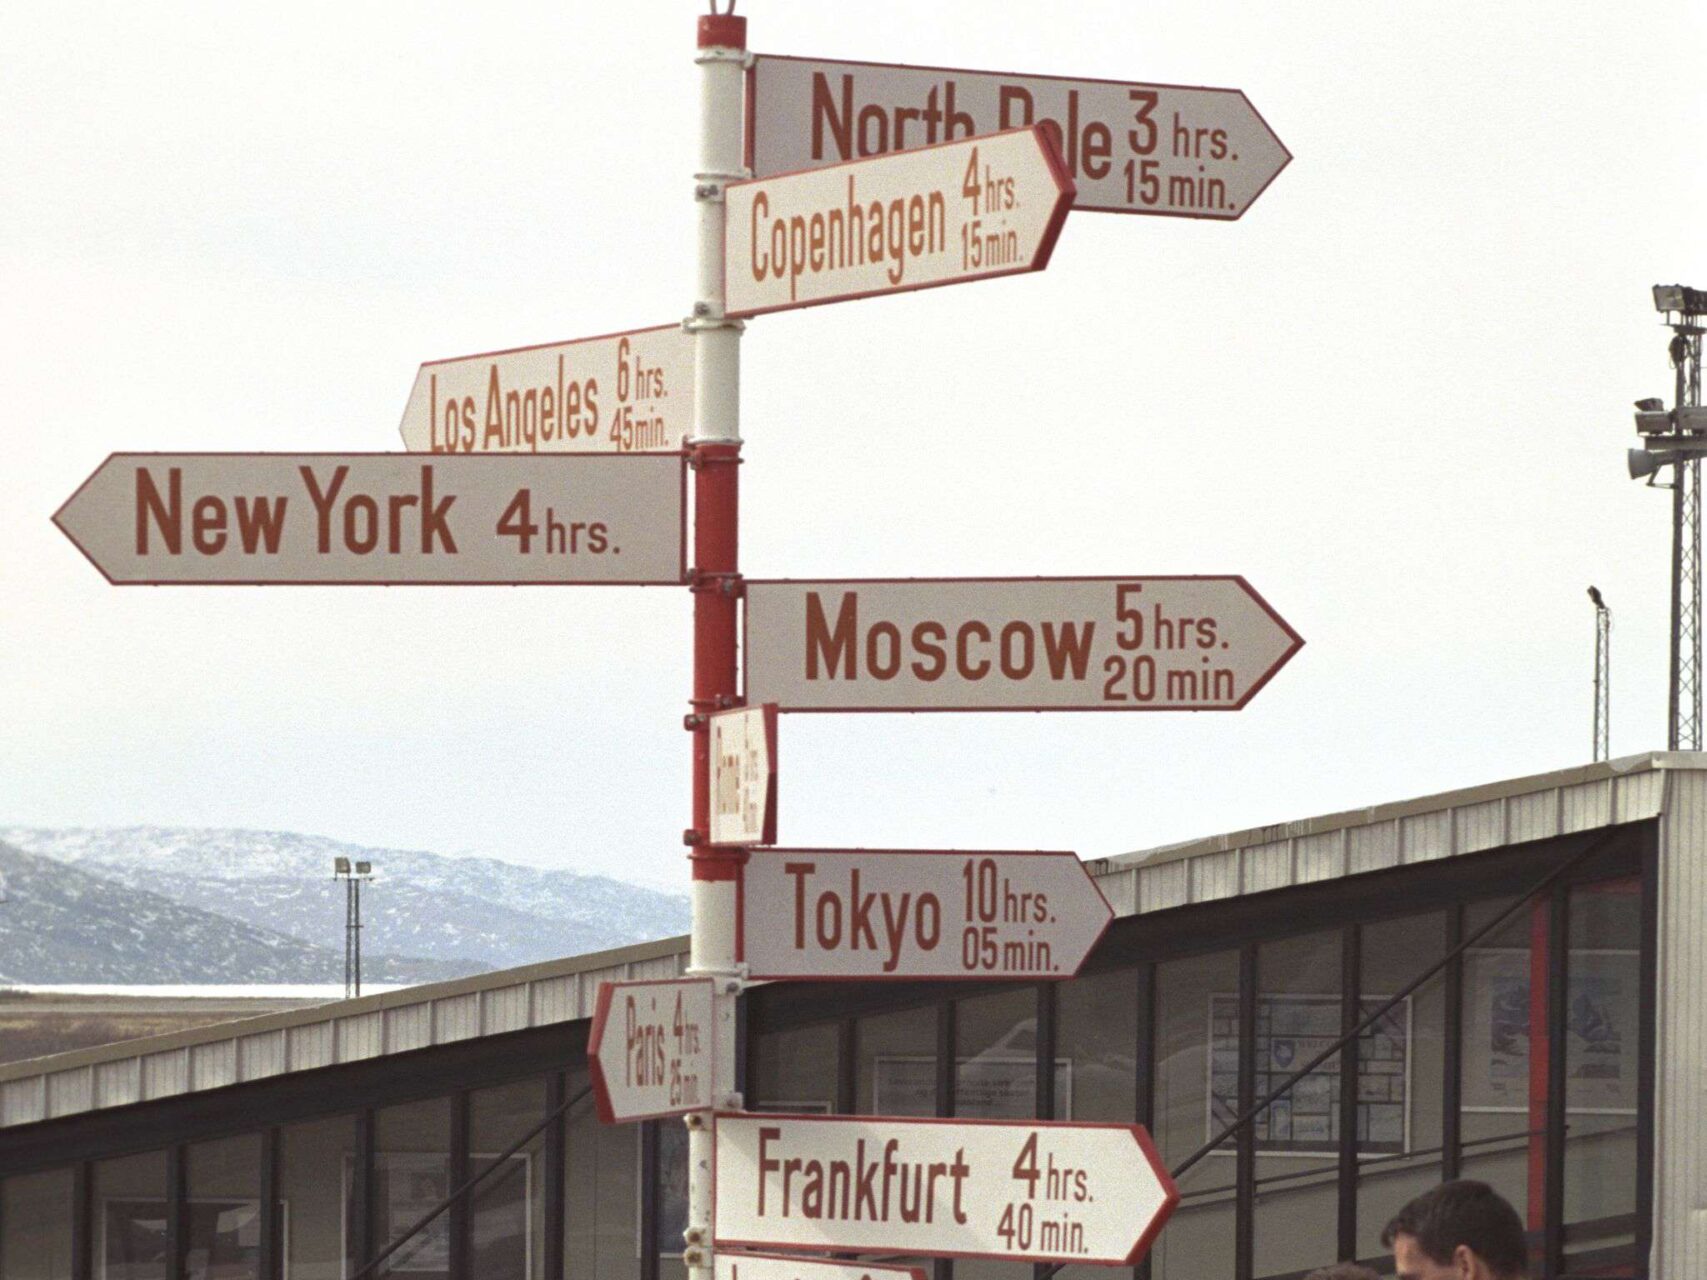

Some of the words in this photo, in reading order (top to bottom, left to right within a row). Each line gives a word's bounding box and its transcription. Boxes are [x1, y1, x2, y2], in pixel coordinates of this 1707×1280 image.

[811, 71, 976, 161] North
[1128, 89, 1158, 156] 3
[1173, 112, 1239, 161] hrs.
[962, 146, 981, 216] 4
[986, 165, 1020, 214] hrs.
[1124, 158, 1160, 205] 15
[1169, 165, 1236, 211] min.
[751, 174, 945, 301] Copenhagen
[961, 219, 982, 270] 15
[985, 219, 1024, 266] min.
[430, 374, 476, 452] Los
[483, 354, 598, 453] Angeles
[617, 336, 630, 403] 6
[636, 356, 668, 401] hrs.
[609, 406, 633, 452] 45
[635, 406, 669, 449] min.
[136, 466, 288, 556] New
[299, 465, 458, 556] York
[496, 489, 539, 555] 4
[546, 507, 621, 555] hrs.
[806, 592, 1096, 682] Moscow
[1116, 584, 1144, 650] 5
[1155, 603, 1229, 650] hrs.
[1103, 655, 1156, 702] 20
[1167, 655, 1234, 701] min
[785, 862, 941, 972] Tokyo
[963, 858, 998, 922] 10
[1004, 878, 1056, 923] hrs.
[962, 926, 997, 971] 05
[1004, 929, 1059, 972] min.
[626, 994, 665, 1087] Paris
[673, 990, 684, 1054] 4
[758, 1127, 970, 1226] Frankfurt
[1013, 1132, 1040, 1200] 4
[1046, 1152, 1093, 1203] hrs.
[997, 1203, 1033, 1251] 40
[1040, 1212, 1089, 1254] min.
